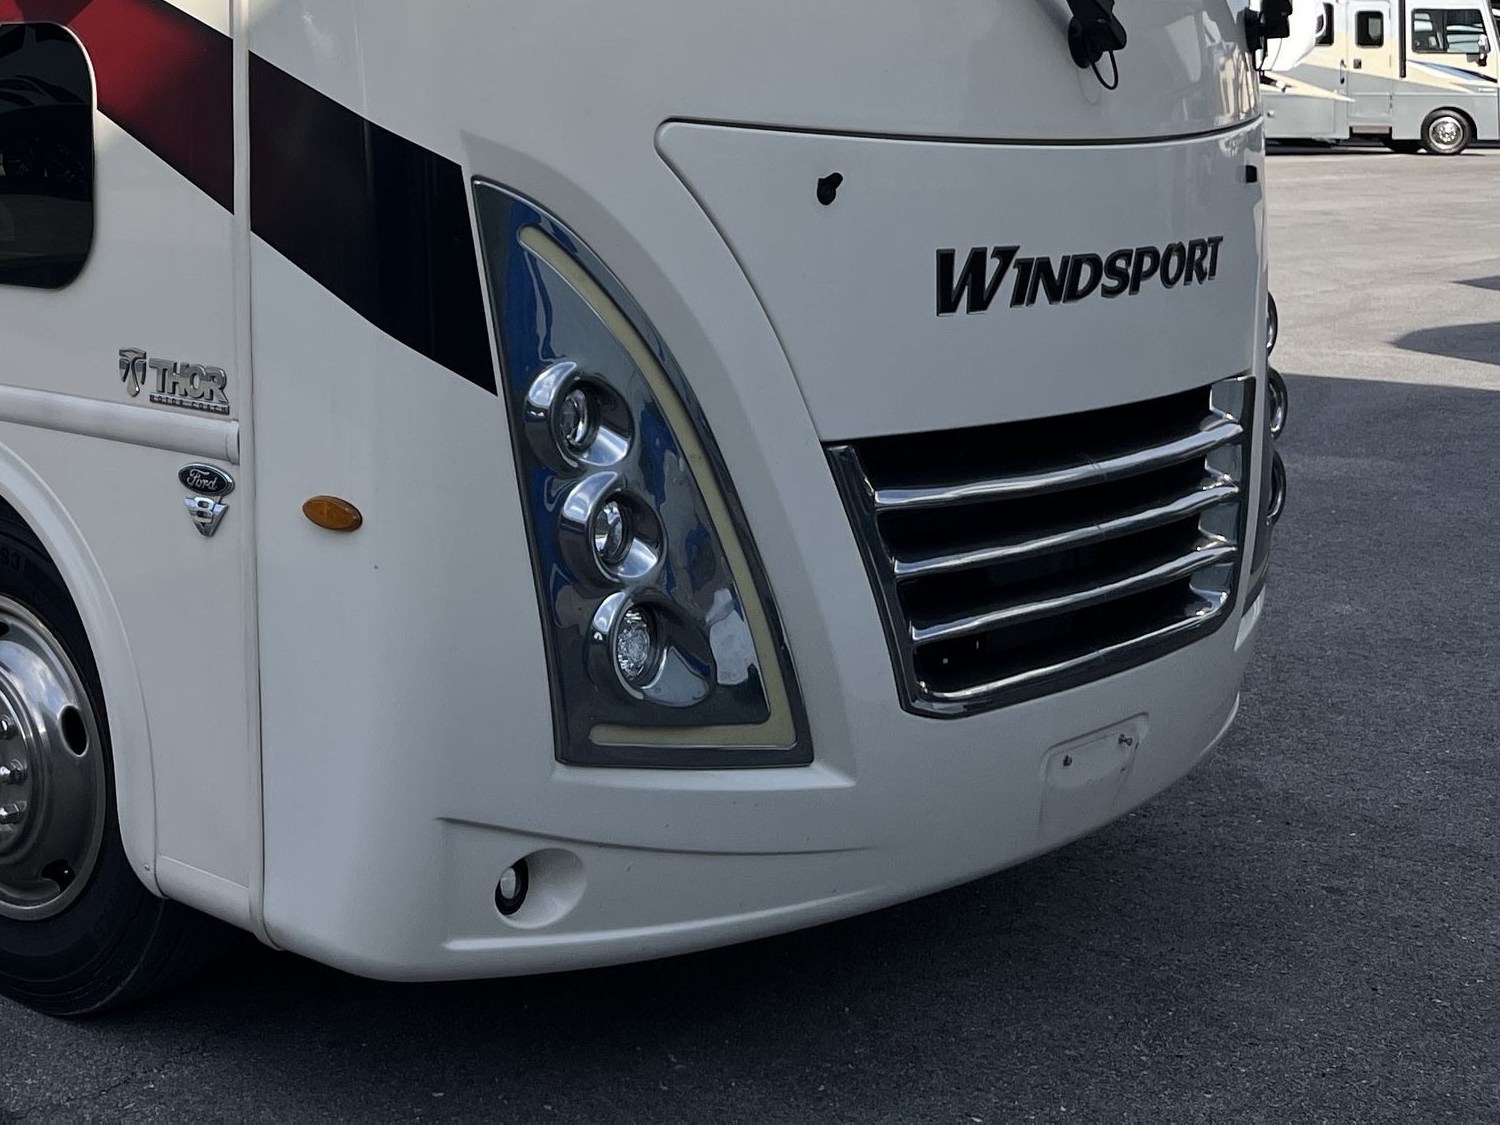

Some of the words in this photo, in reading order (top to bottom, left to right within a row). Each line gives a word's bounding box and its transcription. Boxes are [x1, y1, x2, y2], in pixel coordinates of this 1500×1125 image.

[936, 236, 1224, 317] WINDSPORT
[149, 357, 229, 403] THOR
[150, 394, 185, 408] MOTOR
[191, 401, 229, 414] COACH
[186, 468, 218, 491] Ford
